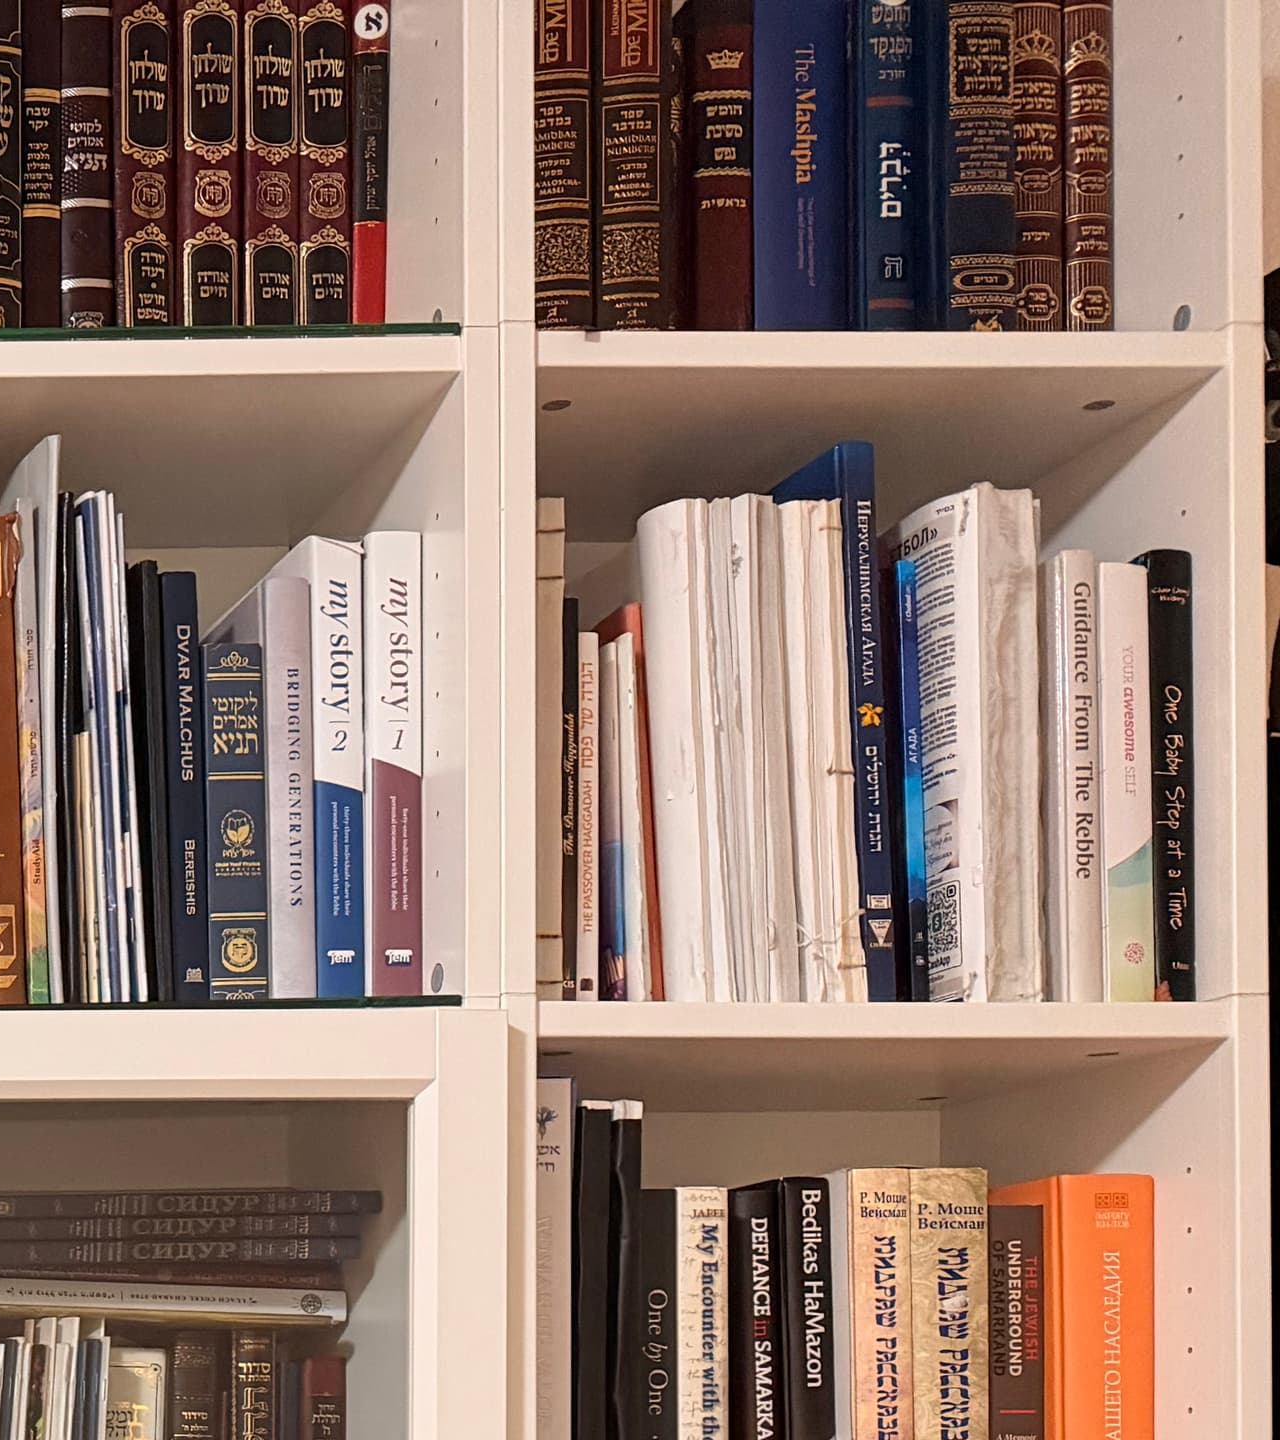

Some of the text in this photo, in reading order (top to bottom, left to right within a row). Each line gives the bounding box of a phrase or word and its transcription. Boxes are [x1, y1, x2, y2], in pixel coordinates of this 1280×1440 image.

[192, 43, 232, 78] שולחן
[195, 82, 229, 107] ערוך
[794, 42, 816, 83] The
[790, 88, 816, 185] Mashpia
[856, 501, 874, 686] ИЕРУСАЛИМСКАЯ АГАДА
[322, 579, 353, 751] my story 2
[178, 624, 196, 915] DVAR MALCHUS BEREISHIS
[1074, 581, 1091, 879] Guidance From The Rebbe
[1123, 686, 1135, 763] awesome
[286, 668, 303, 908] BRIDGING GENERATIONS
[1158, 685, 1186, 930] One Baby Step at a Time
[699, 1223, 718, 1256] My
[751, 1218, 770, 1316] DEFIANCE
[918, 1217, 985, 1231] Вейсман
[702, 1262, 718, 1358] Encounter
[802, 1188, 824, 1388] Bedikas HaMazon
[1007, 1240, 1021, 1377] UNDERGROUND
[1104, 1251, 1122, 1367] НАСЛЕДИЯ
[645, 1289, 669, 1415] One by One
[702, 1363, 717, 1402] with
